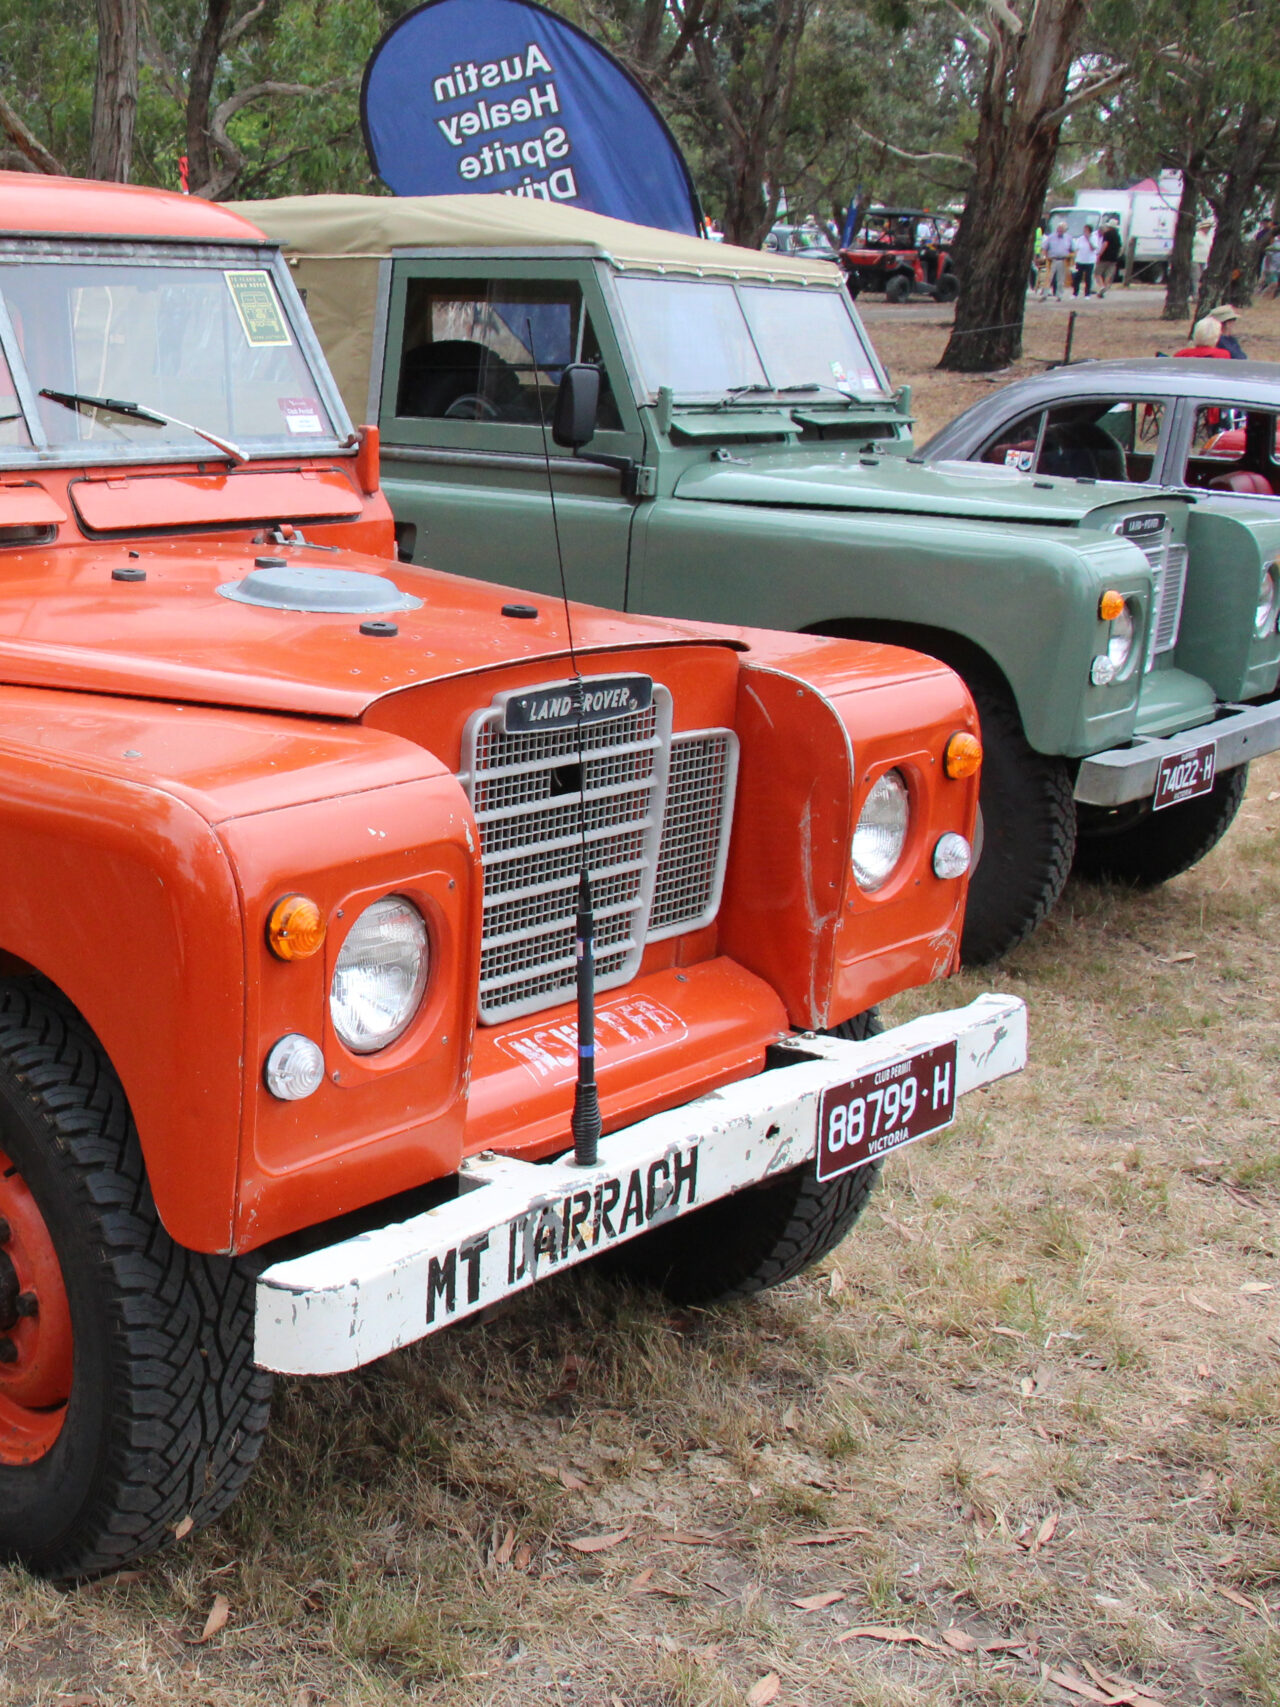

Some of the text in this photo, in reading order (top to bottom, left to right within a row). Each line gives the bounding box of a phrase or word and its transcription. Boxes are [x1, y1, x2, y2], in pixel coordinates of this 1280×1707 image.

[874, 1060, 913, 1086] CLUB PERMIT
[868, 1127, 909, 1154] VICTORIA
[426, 1232, 490, 1325] MT
